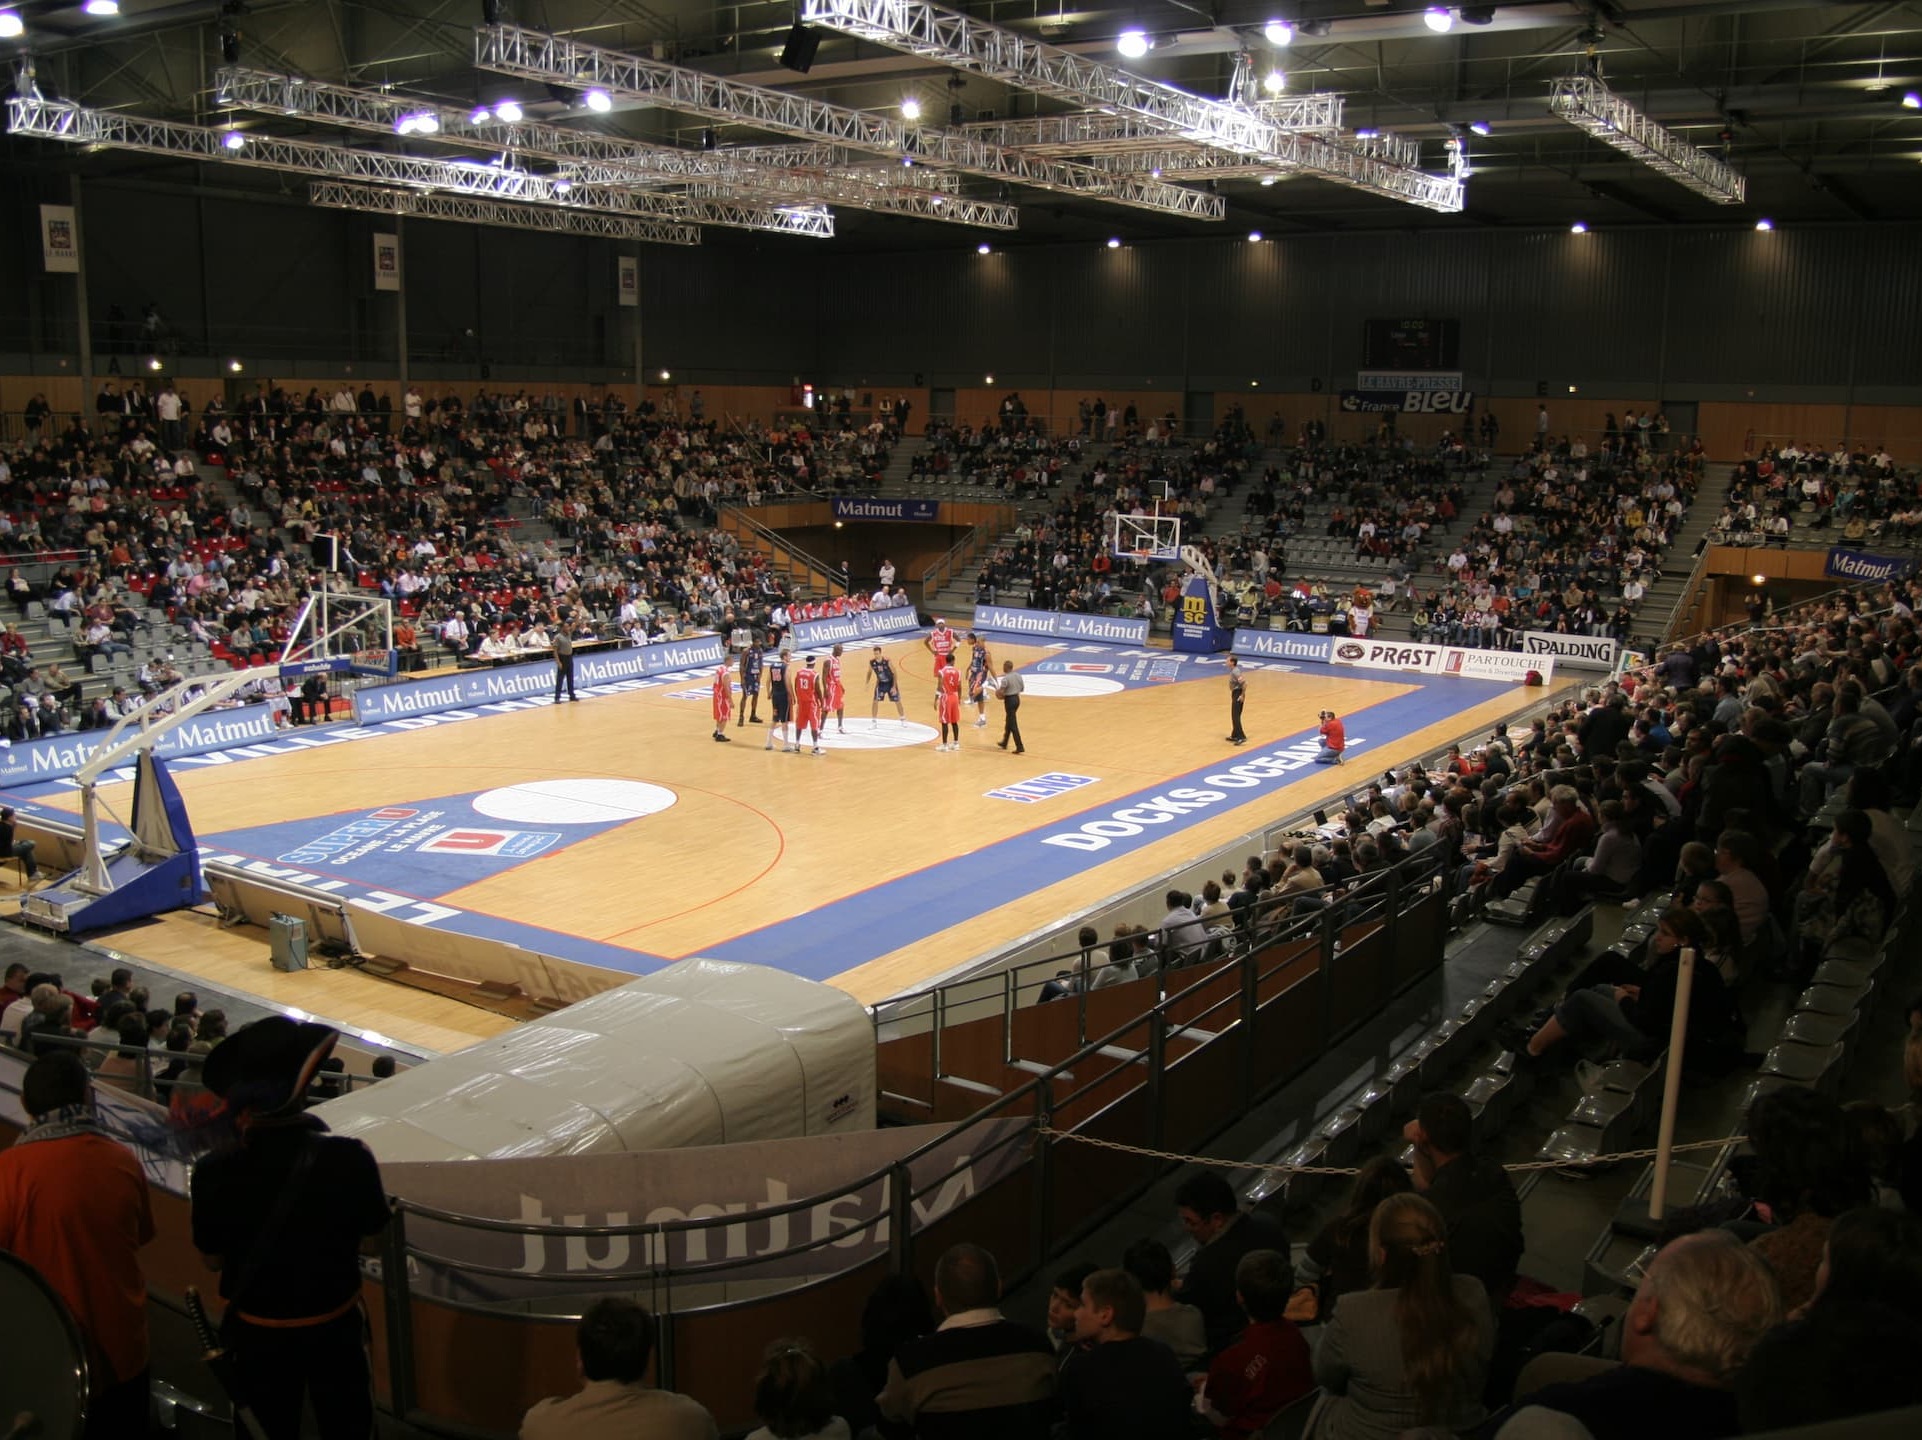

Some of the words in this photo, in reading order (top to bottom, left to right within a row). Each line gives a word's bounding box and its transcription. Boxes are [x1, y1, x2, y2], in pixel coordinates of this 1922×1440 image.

[837, 500, 903, 517] Matmut
[1832, 552, 1893, 580] Matmut
[810, 621, 860, 642] Matmut
[872, 610, 917, 632] Matmut
[991, 612, 1055, 633] Matmut
[1077, 619, 1145, 641] Matmut
[663, 643, 723, 668] Matmut
[1253, 635, 1328, 658] Matmut
[1370, 646, 1437, 667] PRAST
[1527, 637, 1611, 663] SPALDING
[580, 655, 644, 682] Matmut
[1467, 654, 1546, 670] PARTOUCHE
[487, 668, 557, 697] Matmut
[383, 683, 463, 715] Matmut
[171, 727, 388, 765] VILLE
[382, 710, 479, 730] DU
[178, 713, 272, 750] Matmut
[1040, 788, 1228, 852] DOCKS
[1204, 735, 1367, 788] OCEAN
